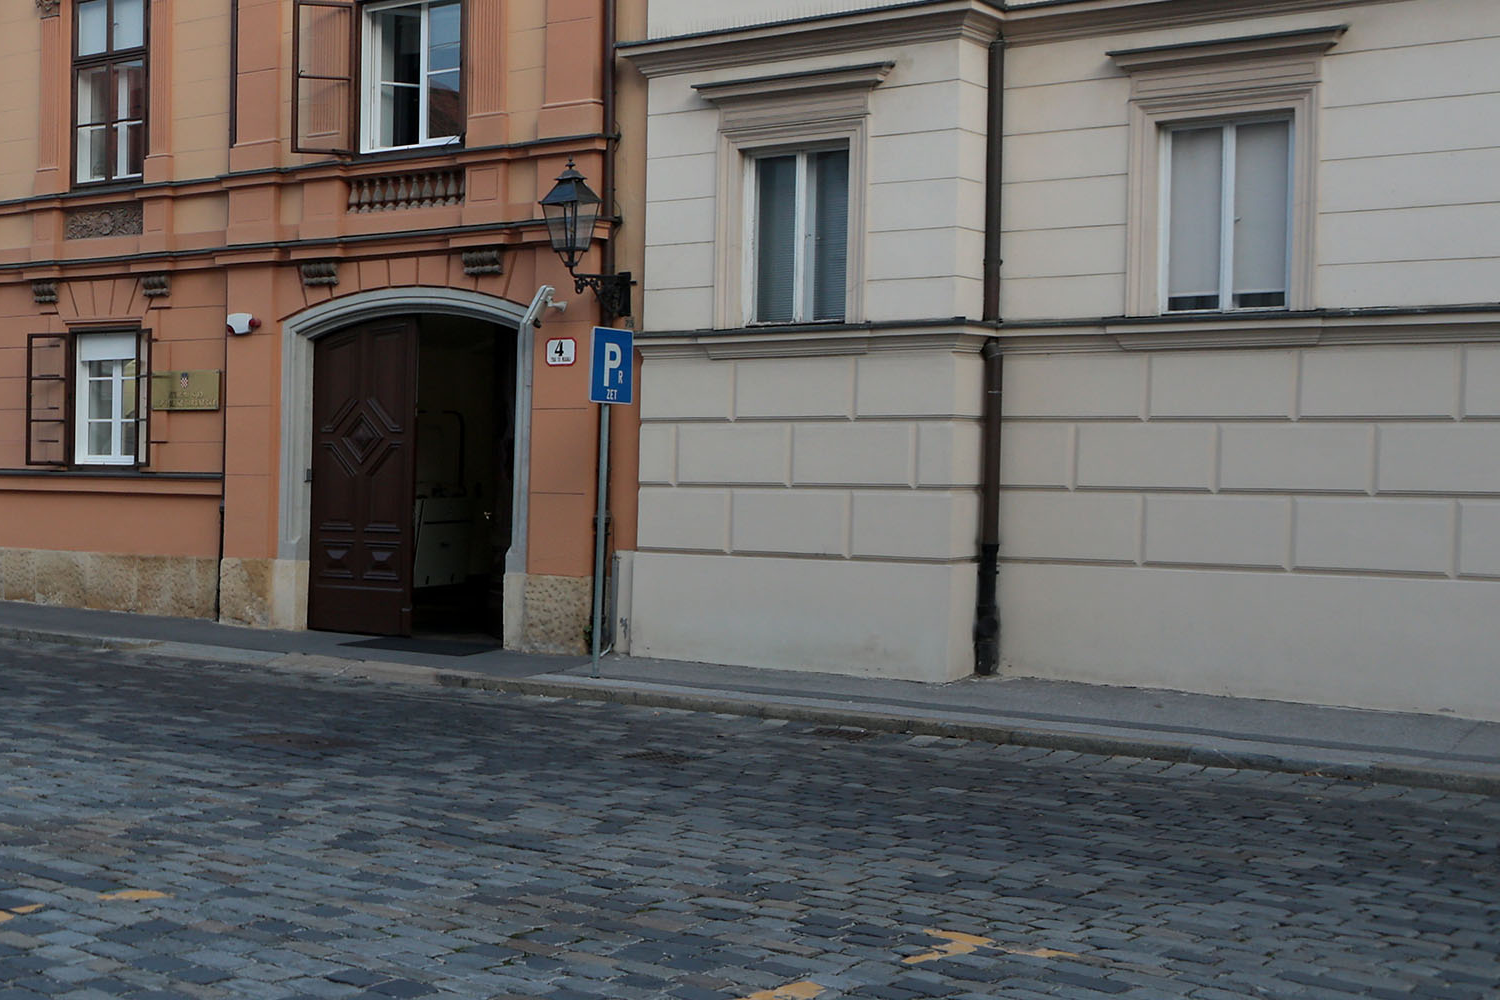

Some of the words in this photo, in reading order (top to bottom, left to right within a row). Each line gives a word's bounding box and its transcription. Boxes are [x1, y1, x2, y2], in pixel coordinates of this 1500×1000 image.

[554, 340, 564, 356] 4
[603, 342, 622, 387] P
[617, 370, 624, 384] R
[606, 388, 618, 400] ZET
